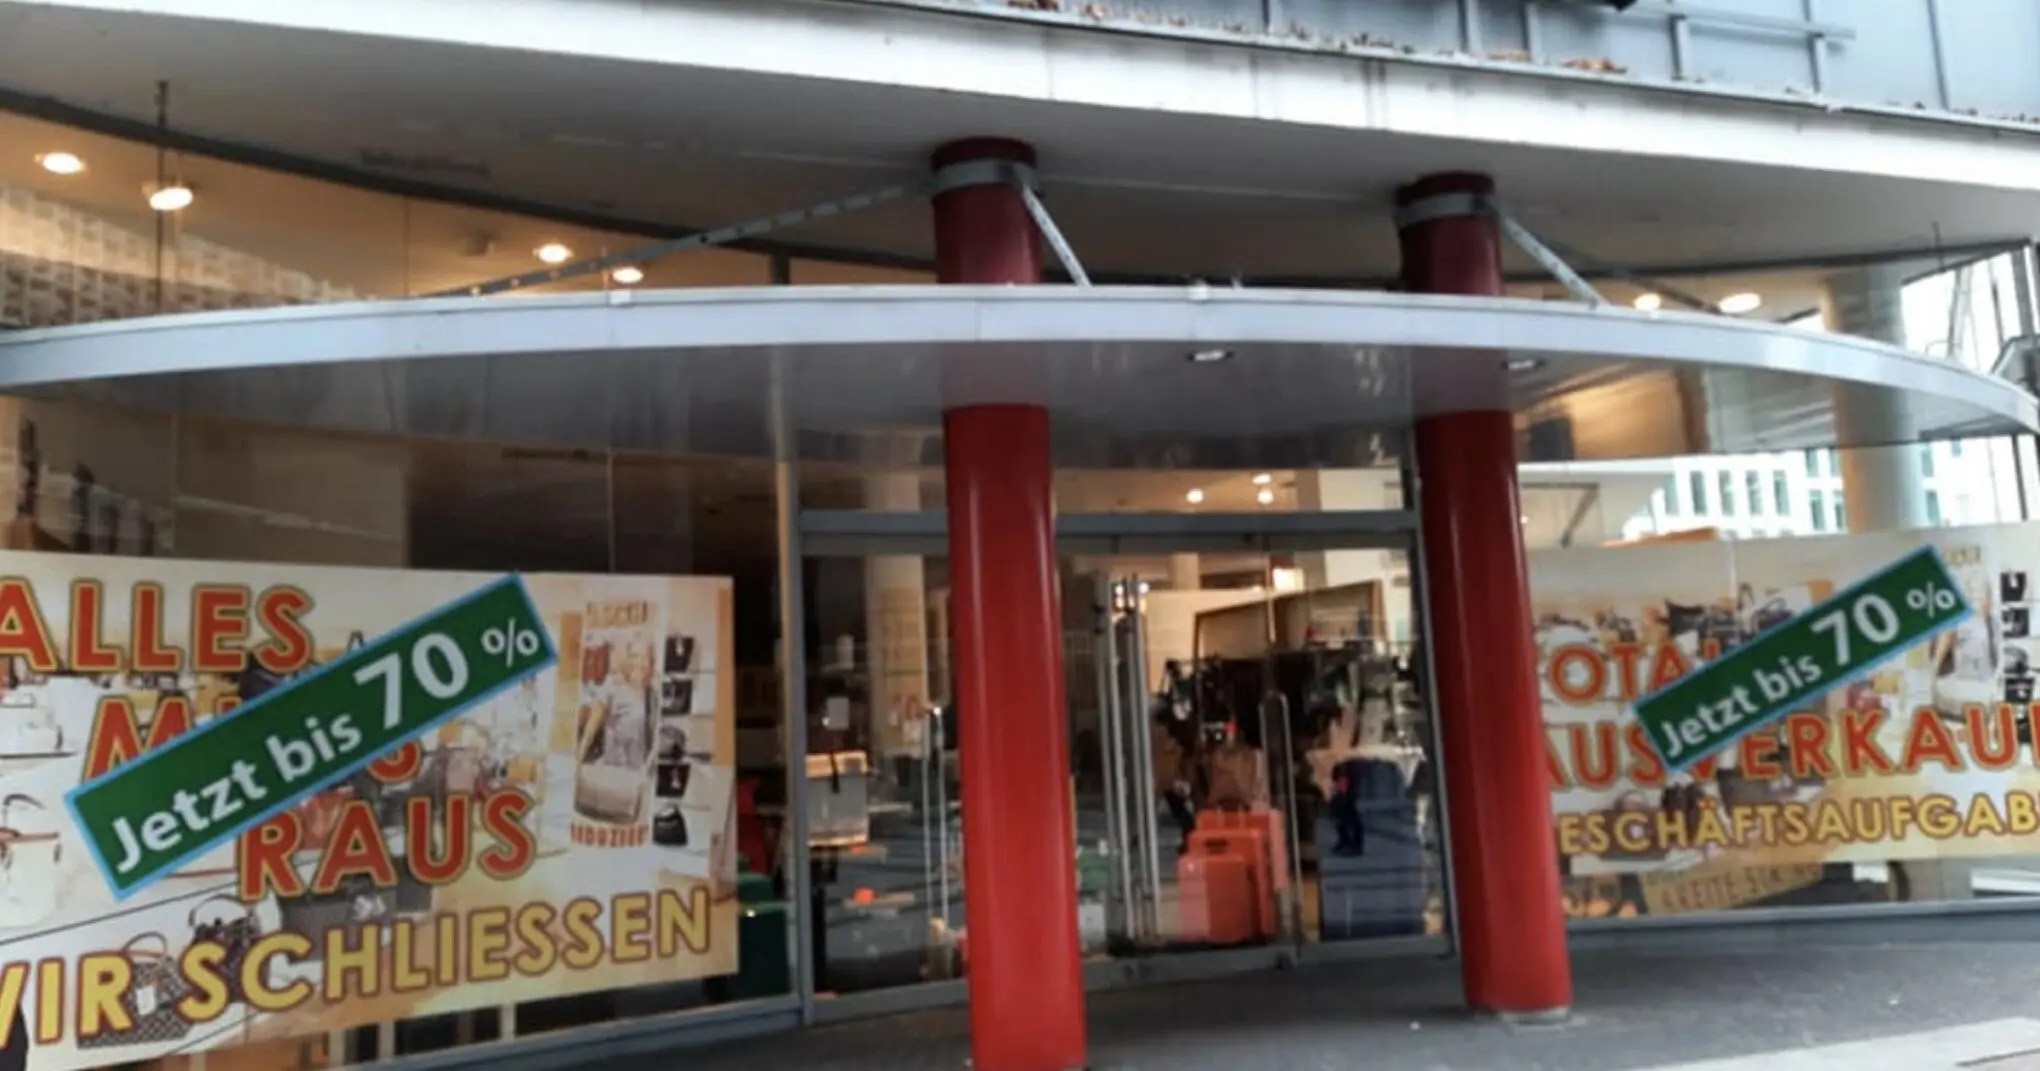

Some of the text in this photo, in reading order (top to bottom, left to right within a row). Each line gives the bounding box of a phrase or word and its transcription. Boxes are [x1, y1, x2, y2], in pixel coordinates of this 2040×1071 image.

[0, 576, 315, 674] ALLES
[1661, 580, 1956, 759] Jetzt bis 70 %
[111, 760, 268, 874] Jetzt
[265, 713, 363, 783] bis
[353, 632, 469, 731] 70
[480, 617, 541, 669] %
[235, 789, 538, 901] RAUS
[175, 884, 713, 1024] SCHLIESSEN
